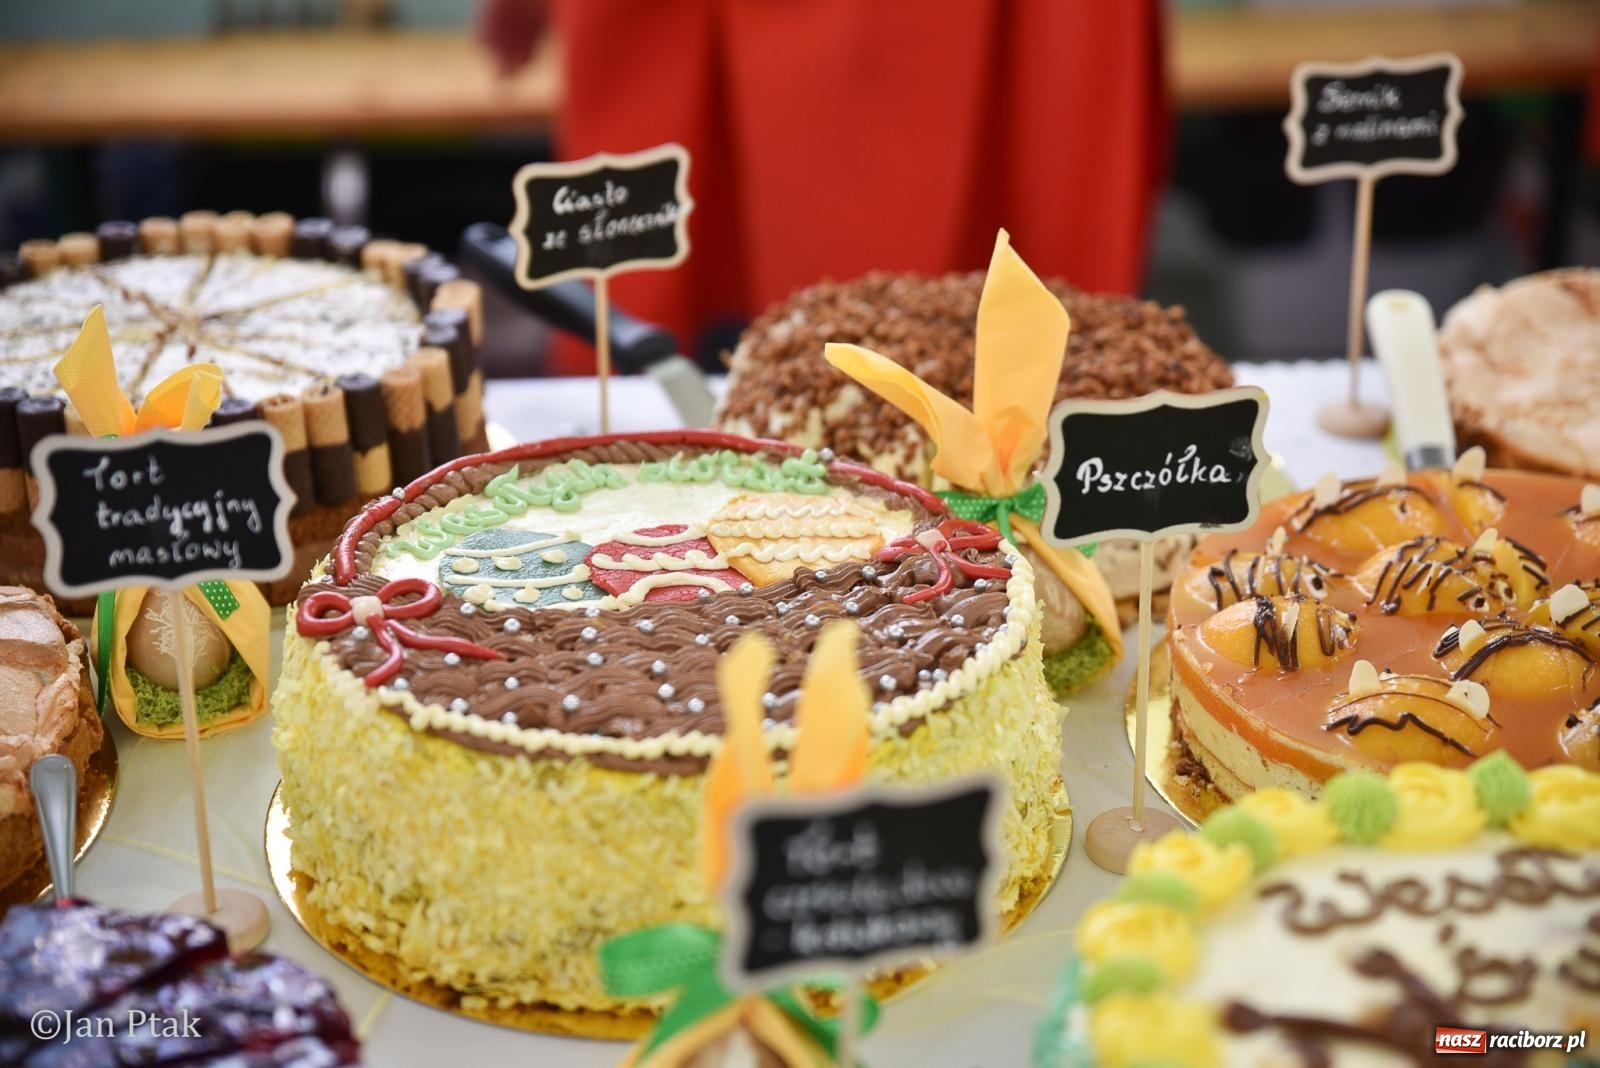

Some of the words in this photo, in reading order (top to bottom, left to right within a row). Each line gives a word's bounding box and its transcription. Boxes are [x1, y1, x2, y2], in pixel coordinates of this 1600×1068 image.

[553, 180, 629, 215] Ciasto
[83, 456, 165, 491] Tort
[1076, 444, 1231, 494] Pszczółka
[95, 489, 262, 535] tradycyjny
[108, 529, 241, 569] masłowy
